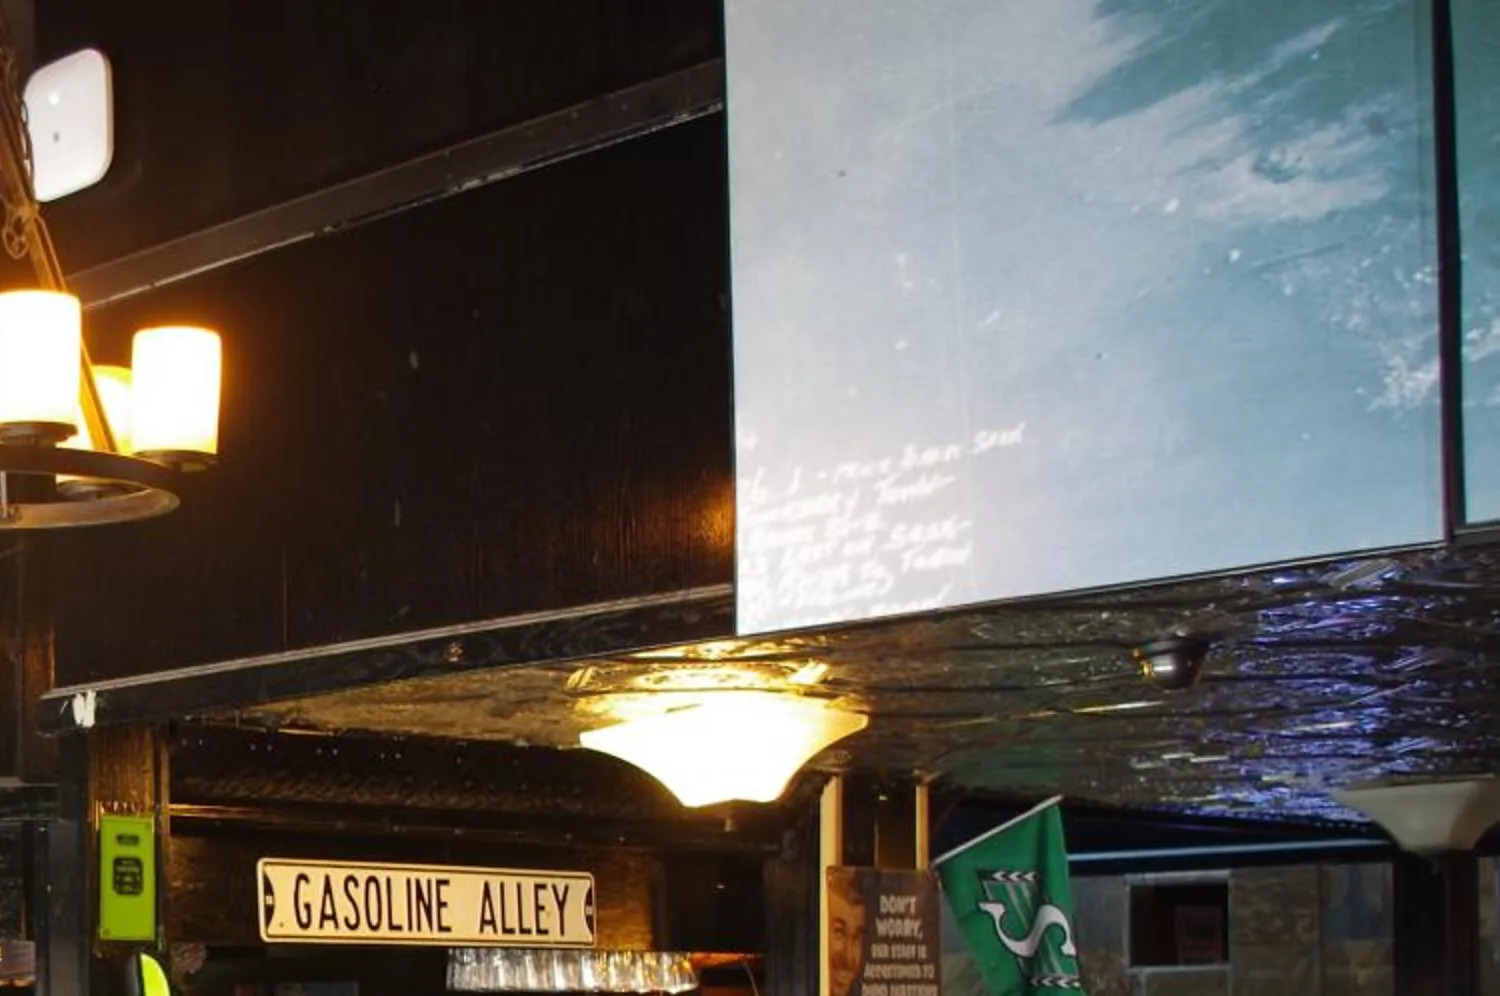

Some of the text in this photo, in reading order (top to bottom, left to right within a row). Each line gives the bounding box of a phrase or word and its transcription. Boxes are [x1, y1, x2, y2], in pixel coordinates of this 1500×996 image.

[293, 872, 570, 937] GASOLINE ALLEY
[879, 894, 917, 914] DON'T
